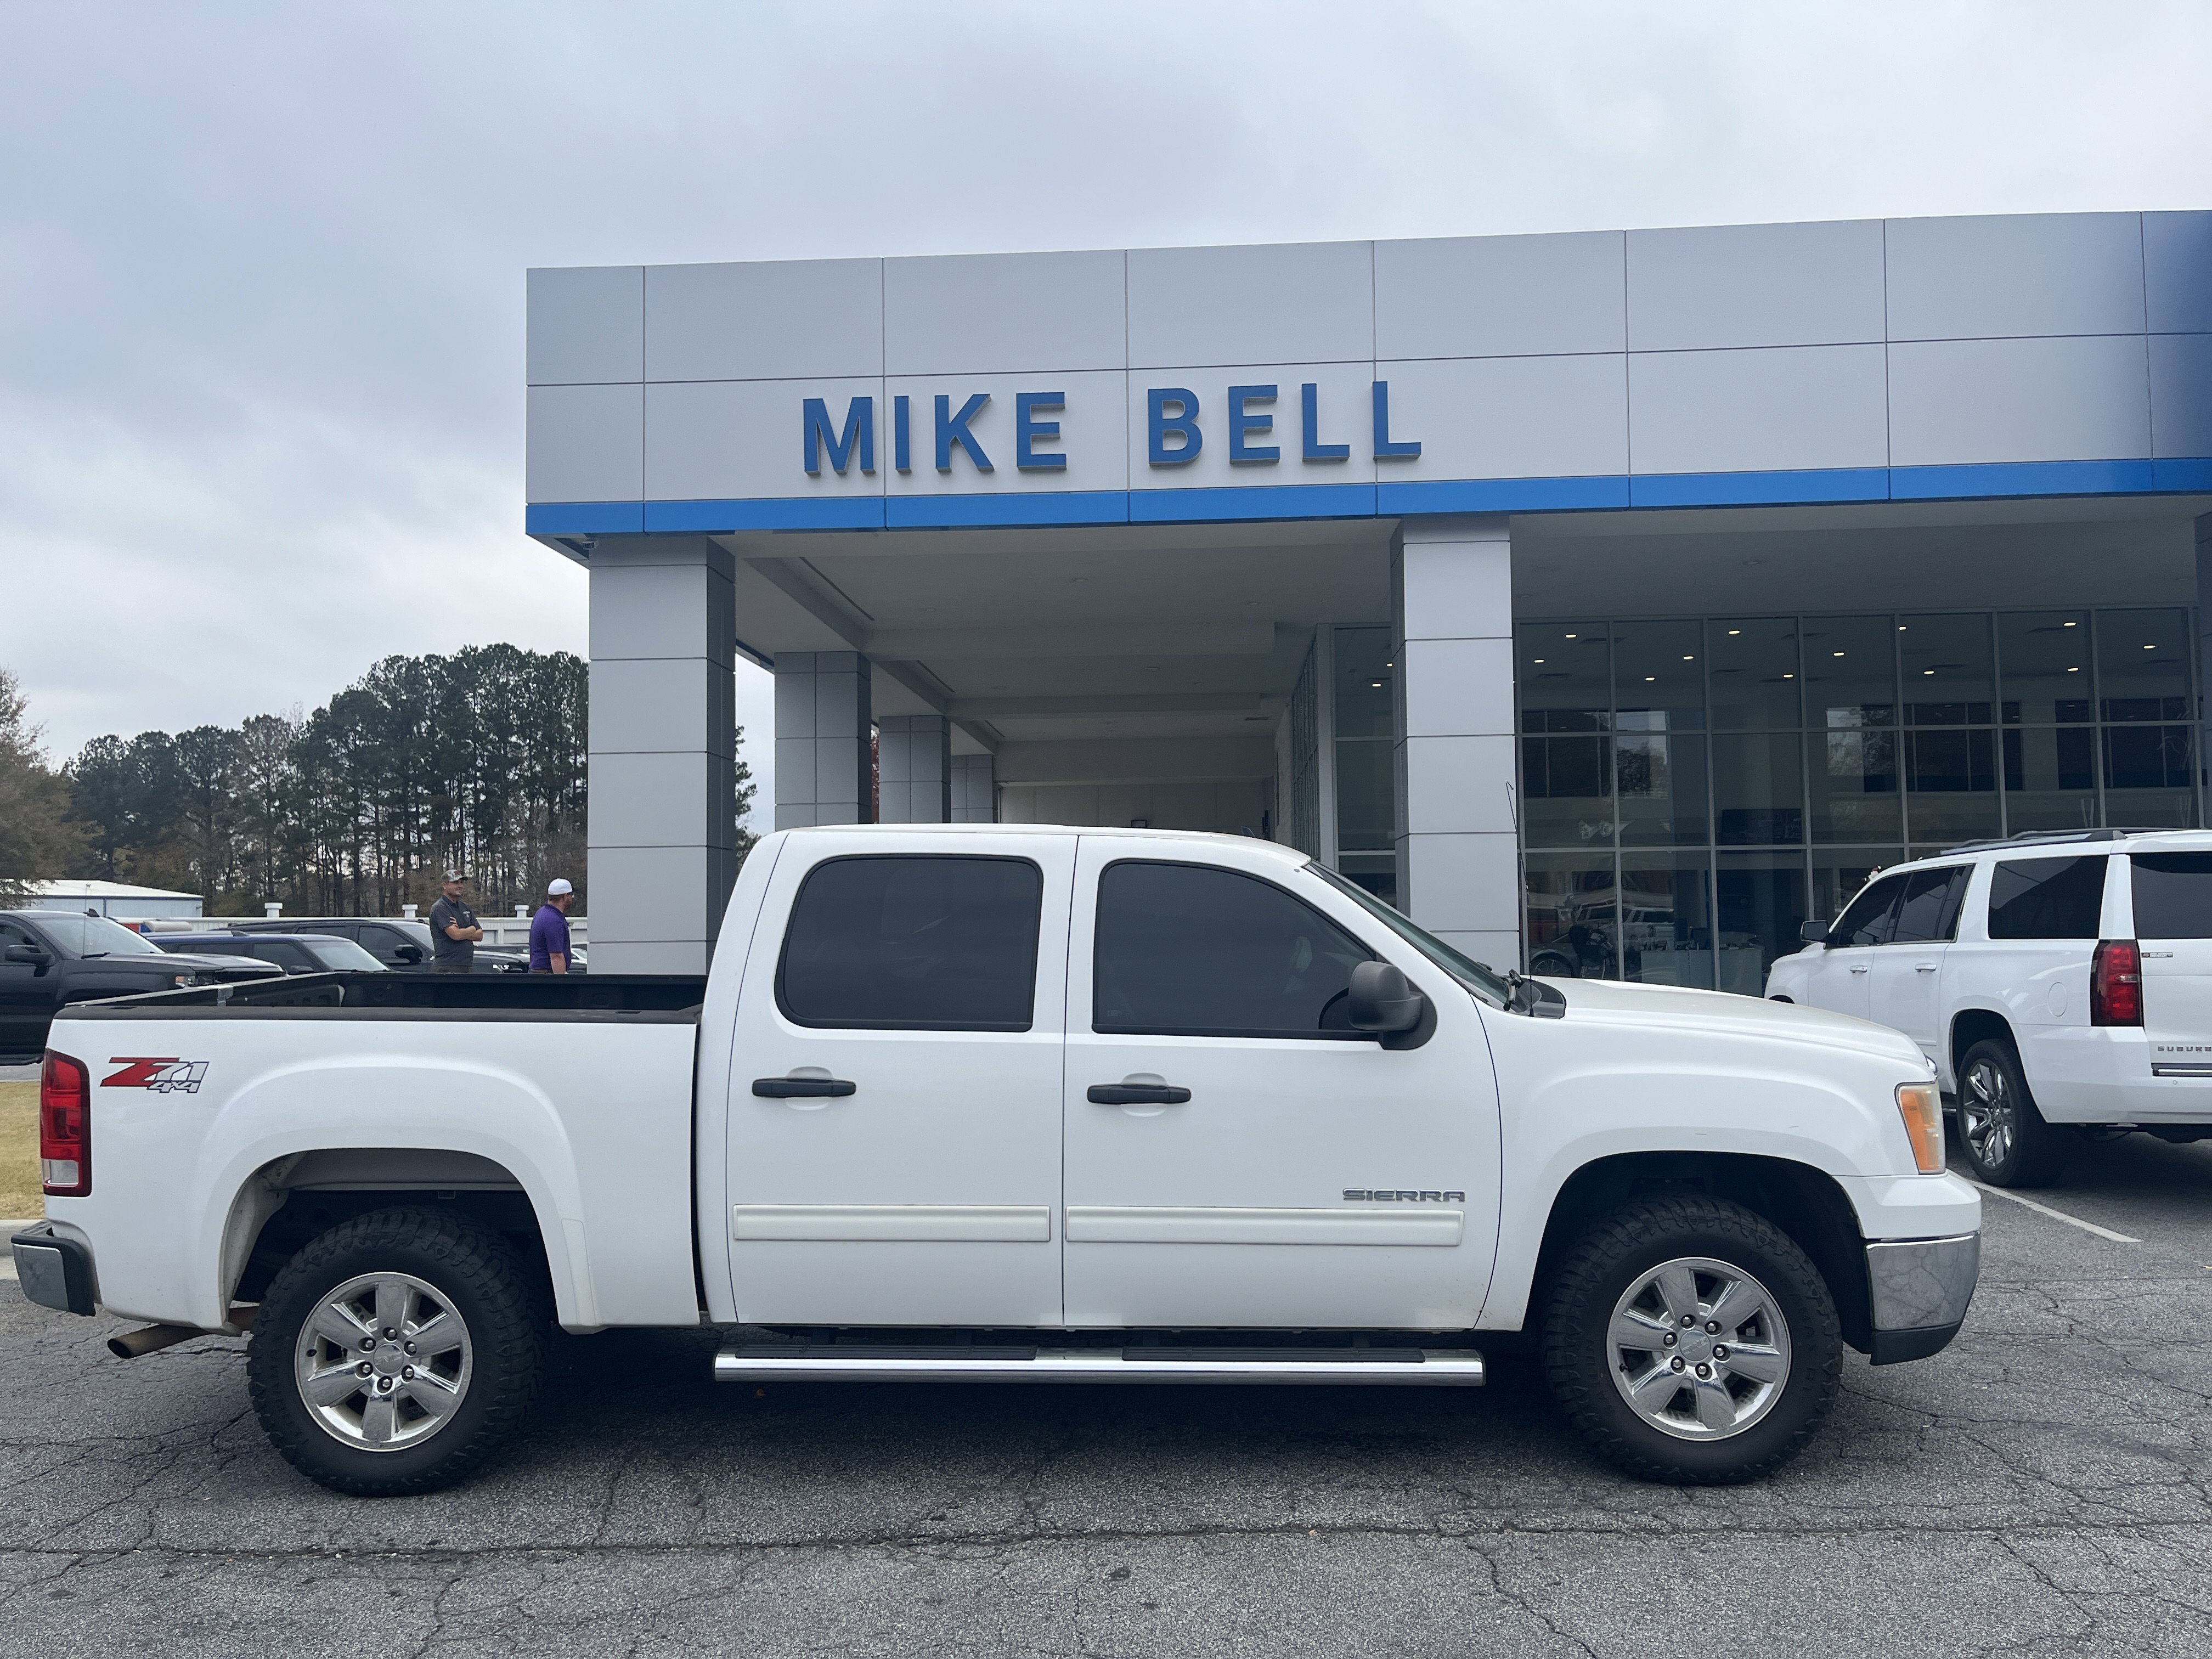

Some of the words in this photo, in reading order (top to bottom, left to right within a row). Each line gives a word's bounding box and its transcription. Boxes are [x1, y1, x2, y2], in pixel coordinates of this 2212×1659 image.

[803, 391, 1067, 475] MIKE
[1148, 381, 1422, 467] BELL
[100, 1057, 210, 1087] Z71
[1343, 1188, 1465, 1202] SIERRA
